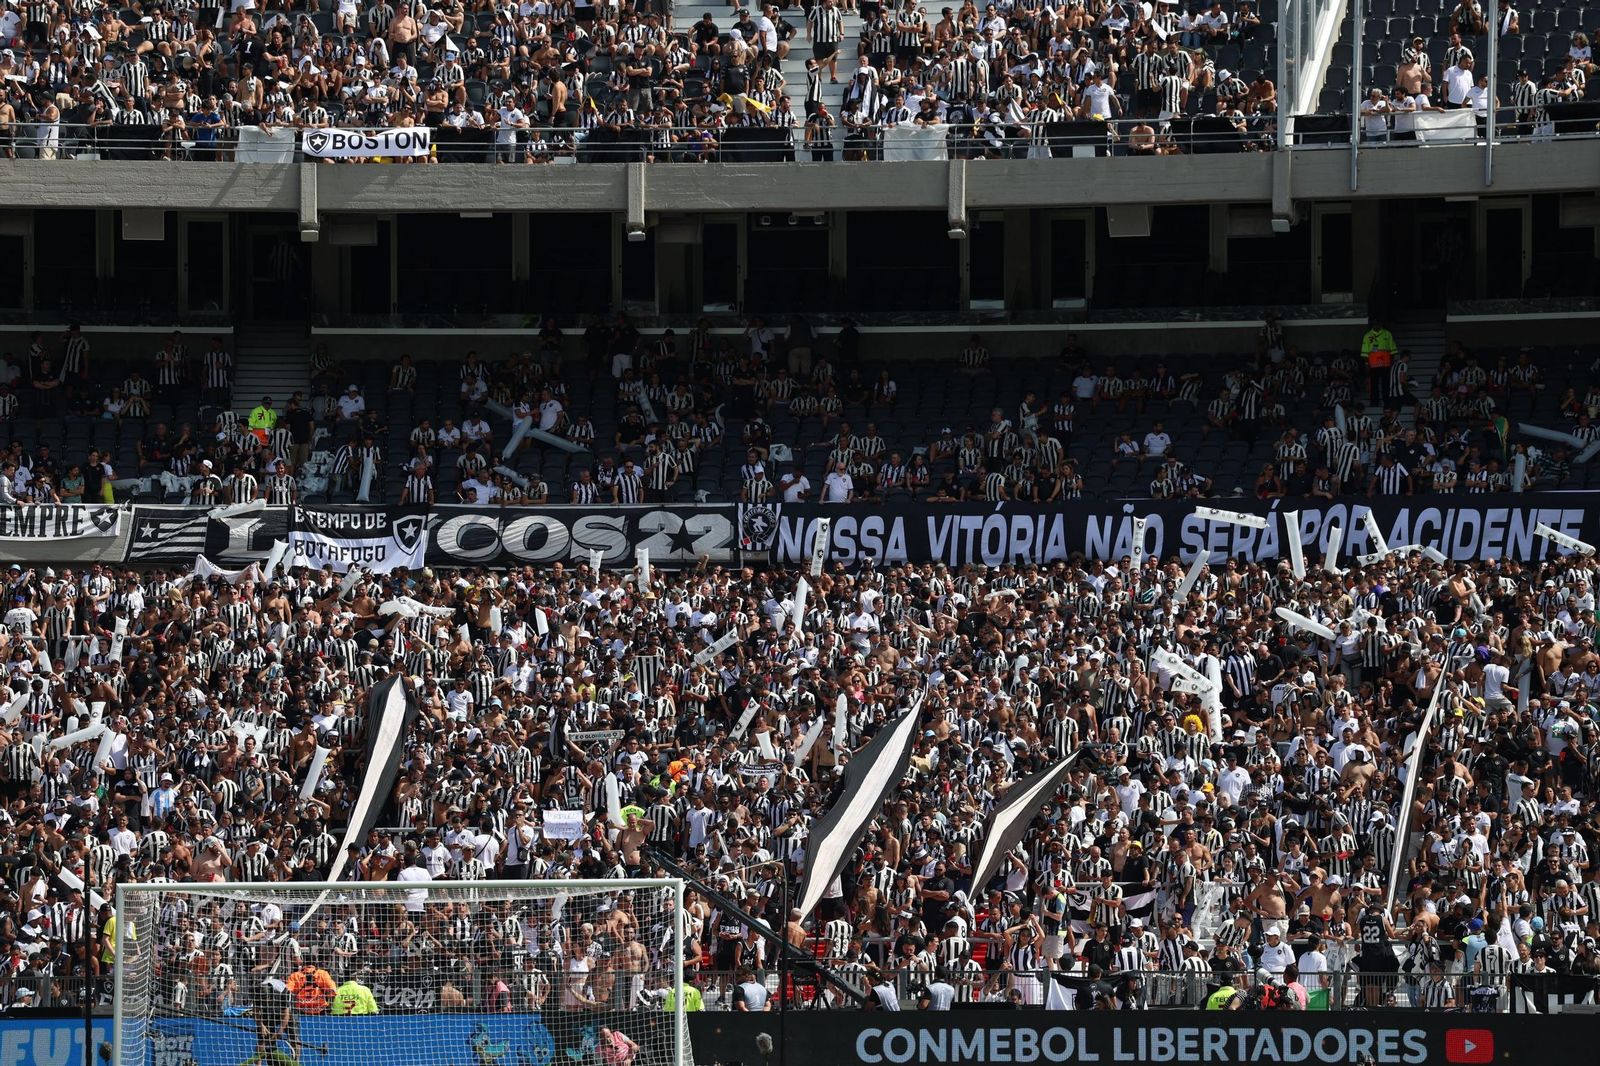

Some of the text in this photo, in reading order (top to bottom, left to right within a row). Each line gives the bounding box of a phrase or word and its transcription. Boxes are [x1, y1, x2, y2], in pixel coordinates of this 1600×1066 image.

[332, 131, 428, 150] BOSTON
[0, 505, 86, 537] EMPRE
[306, 511, 361, 530] TEMPO
[364, 513, 387, 530] DE
[777, 499, 1585, 567] NOSSA VITÓRIA NÃO SERÁ POR ACIDENTE
[294, 539, 387, 562] BOTAFOGO
[1362, 925, 1380, 944] 22
[2, 1027, 105, 1066] FUT
[855, 1026, 1428, 1064] CONMEBOL LIBERTADORES
